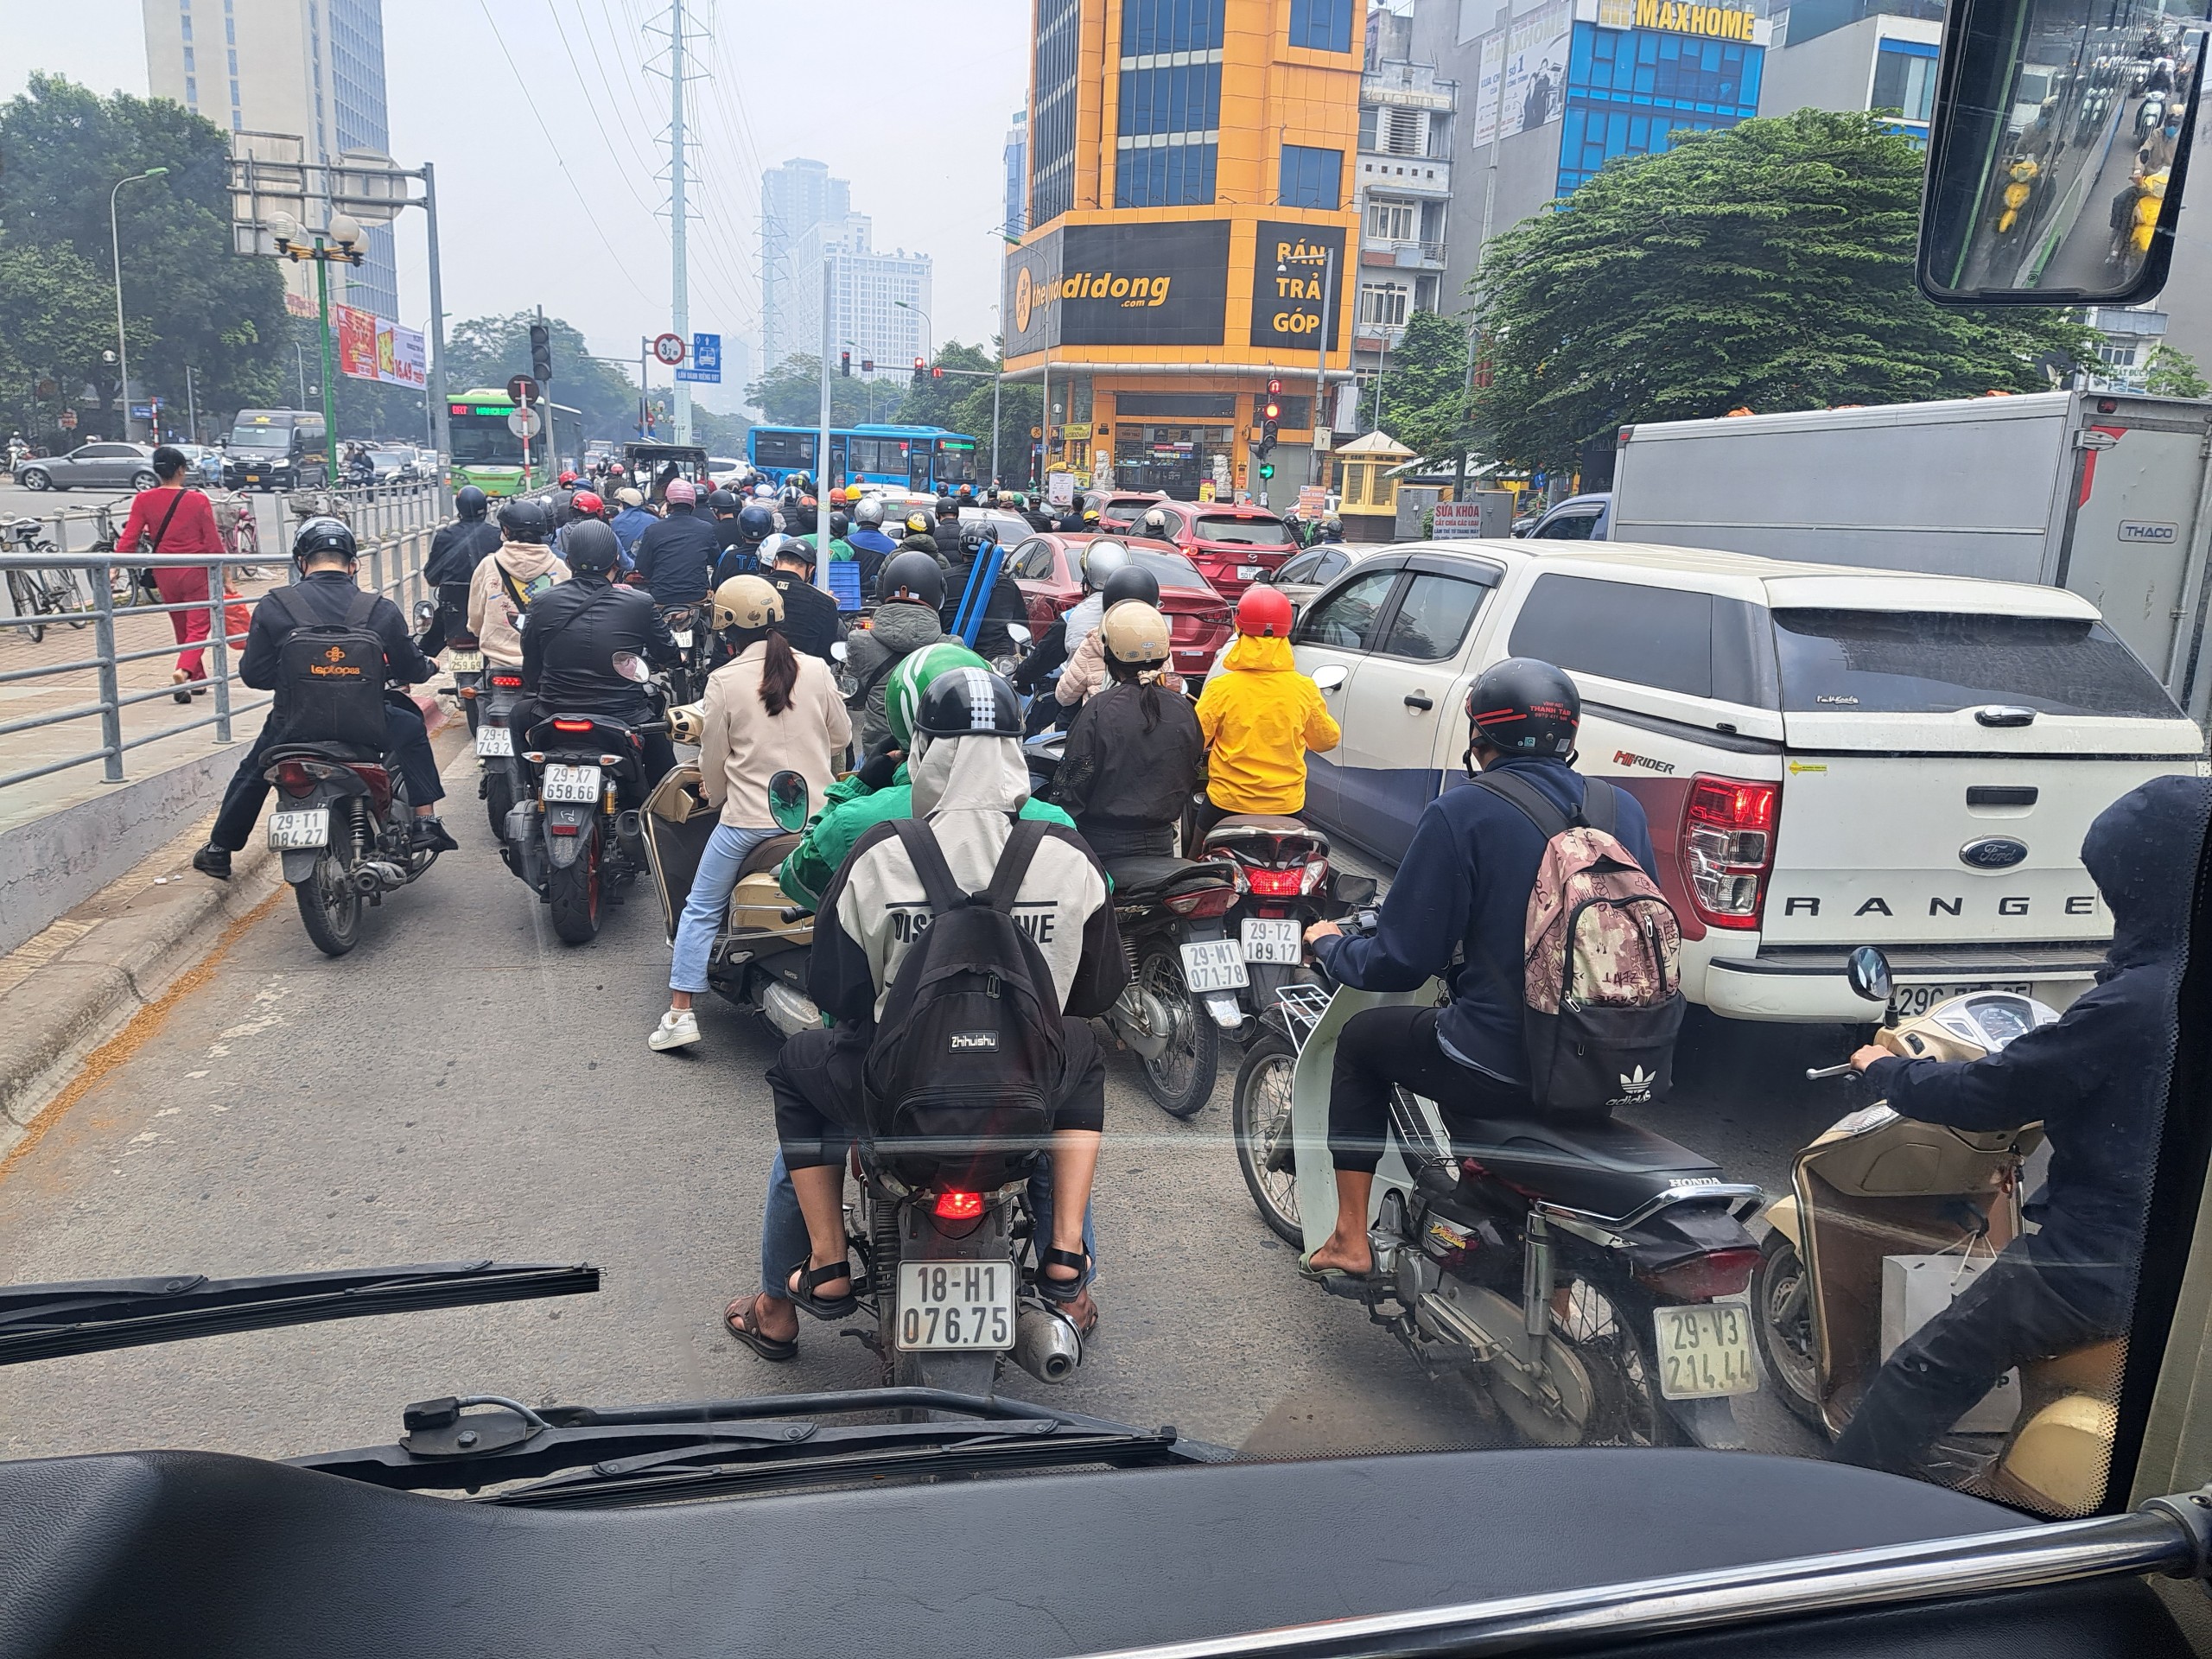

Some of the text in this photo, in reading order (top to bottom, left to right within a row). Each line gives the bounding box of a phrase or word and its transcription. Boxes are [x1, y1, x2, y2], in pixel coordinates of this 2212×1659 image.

[1636, 0, 1756, 41] MAXHOME
[1277, 238, 1325, 265] BÁN
[1275, 272, 1322, 300] TRẢ
[1121, 299, 1145, 308] .com
[1273, 308, 1319, 334] GÓP
[1456, 503, 1479, 518] KHÓA
[2126, 525, 2173, 538] THACO
[451, 662, 481, 671] 259.69
[553, 768, 591, 783] 29-X7
[547, 784, 594, 800] 658.66
[276, 813, 318, 830] 29-T1
[271, 829, 323, 847] 084.27
[1980, 843, 2016, 861] Ford
[1250, 922, 1291, 941] 29-T2
[1191, 944, 1234, 967] 29-M1
[1247, 943, 1296, 962] 189.17
[1191, 964, 1244, 988] 071.78
[951, 1035, 995, 1048] Zhihuishu
[1605, 1090, 1651, 1106] adidas
[1669, 1177, 1722, 1187] HONDA
[918, 1267, 995, 1302] 18-H1
[904, 1307, 1007, 1344] 076.75
[1667, 1350, 1751, 1390] 214.44
